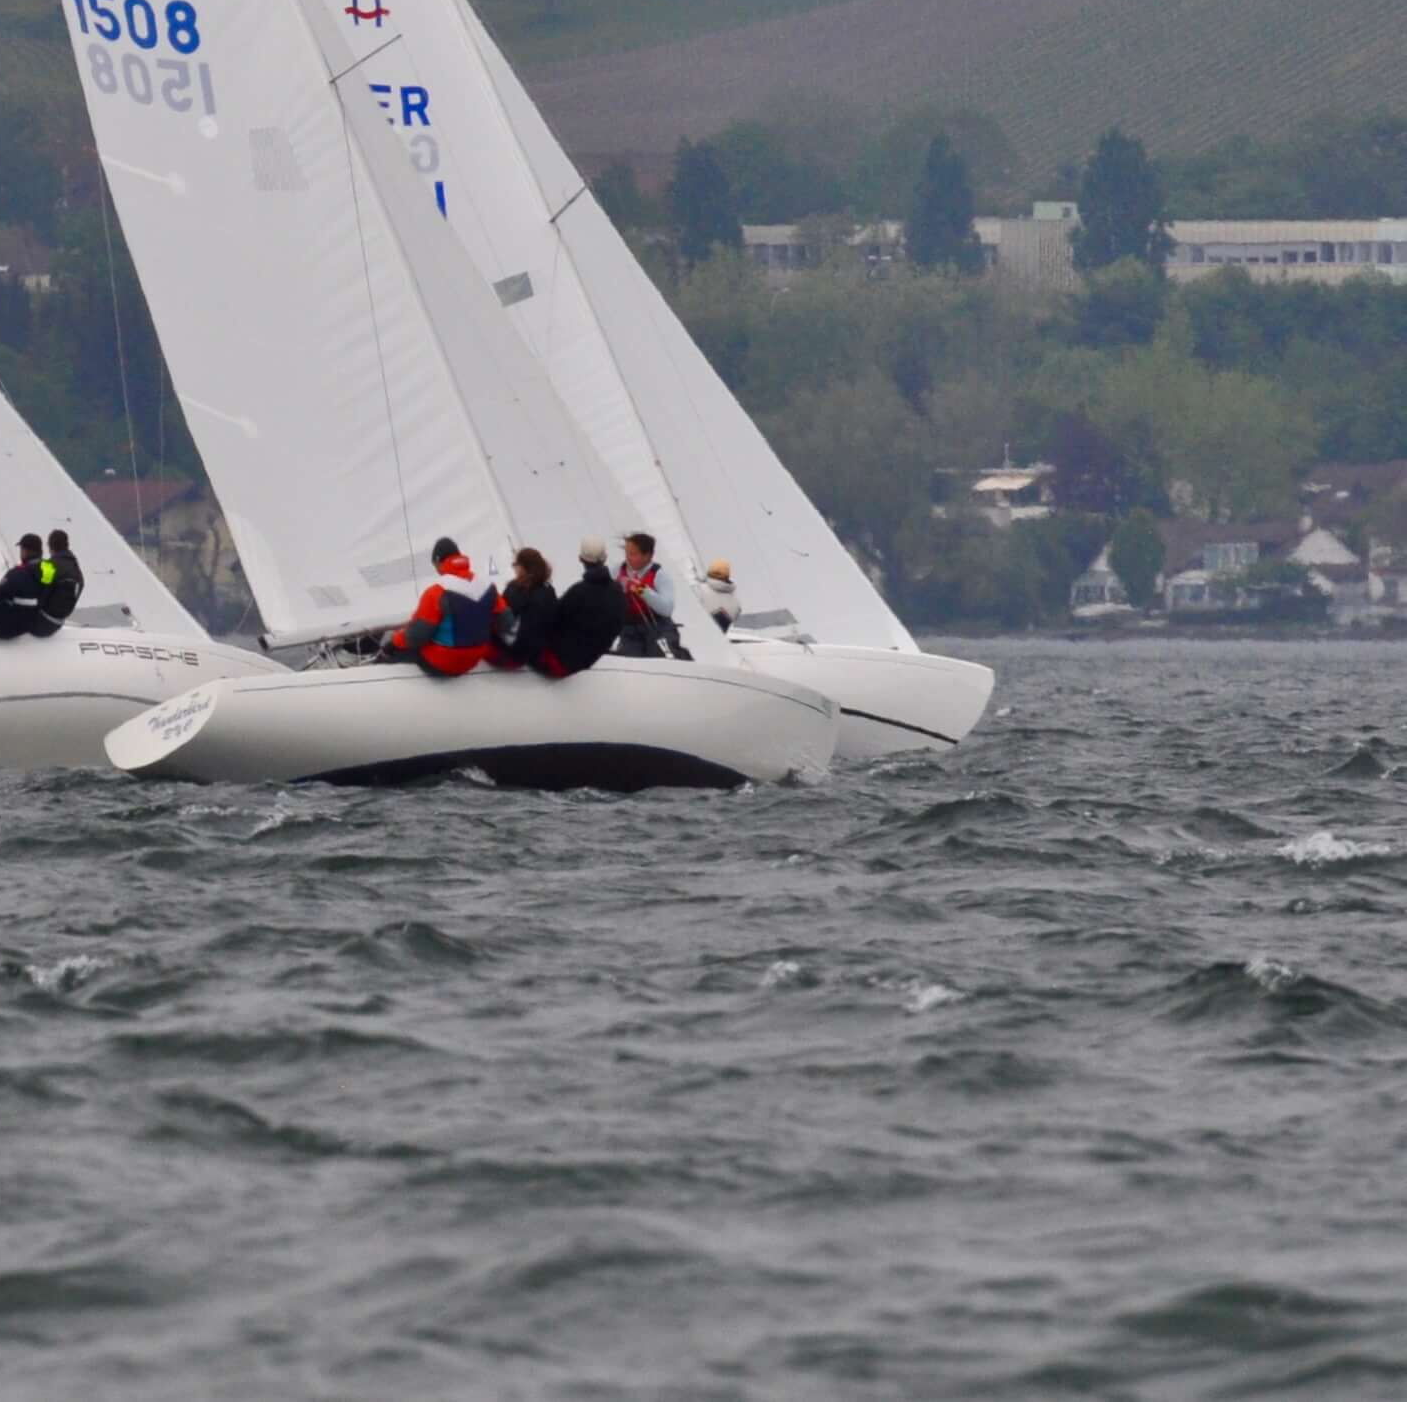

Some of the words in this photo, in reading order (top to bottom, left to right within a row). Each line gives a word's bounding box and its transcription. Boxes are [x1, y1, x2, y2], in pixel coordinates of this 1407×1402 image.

[368, 83, 432, 127] ER
[434, 181, 447, 220] 1
[78, 642, 199, 666] PORSCHE
